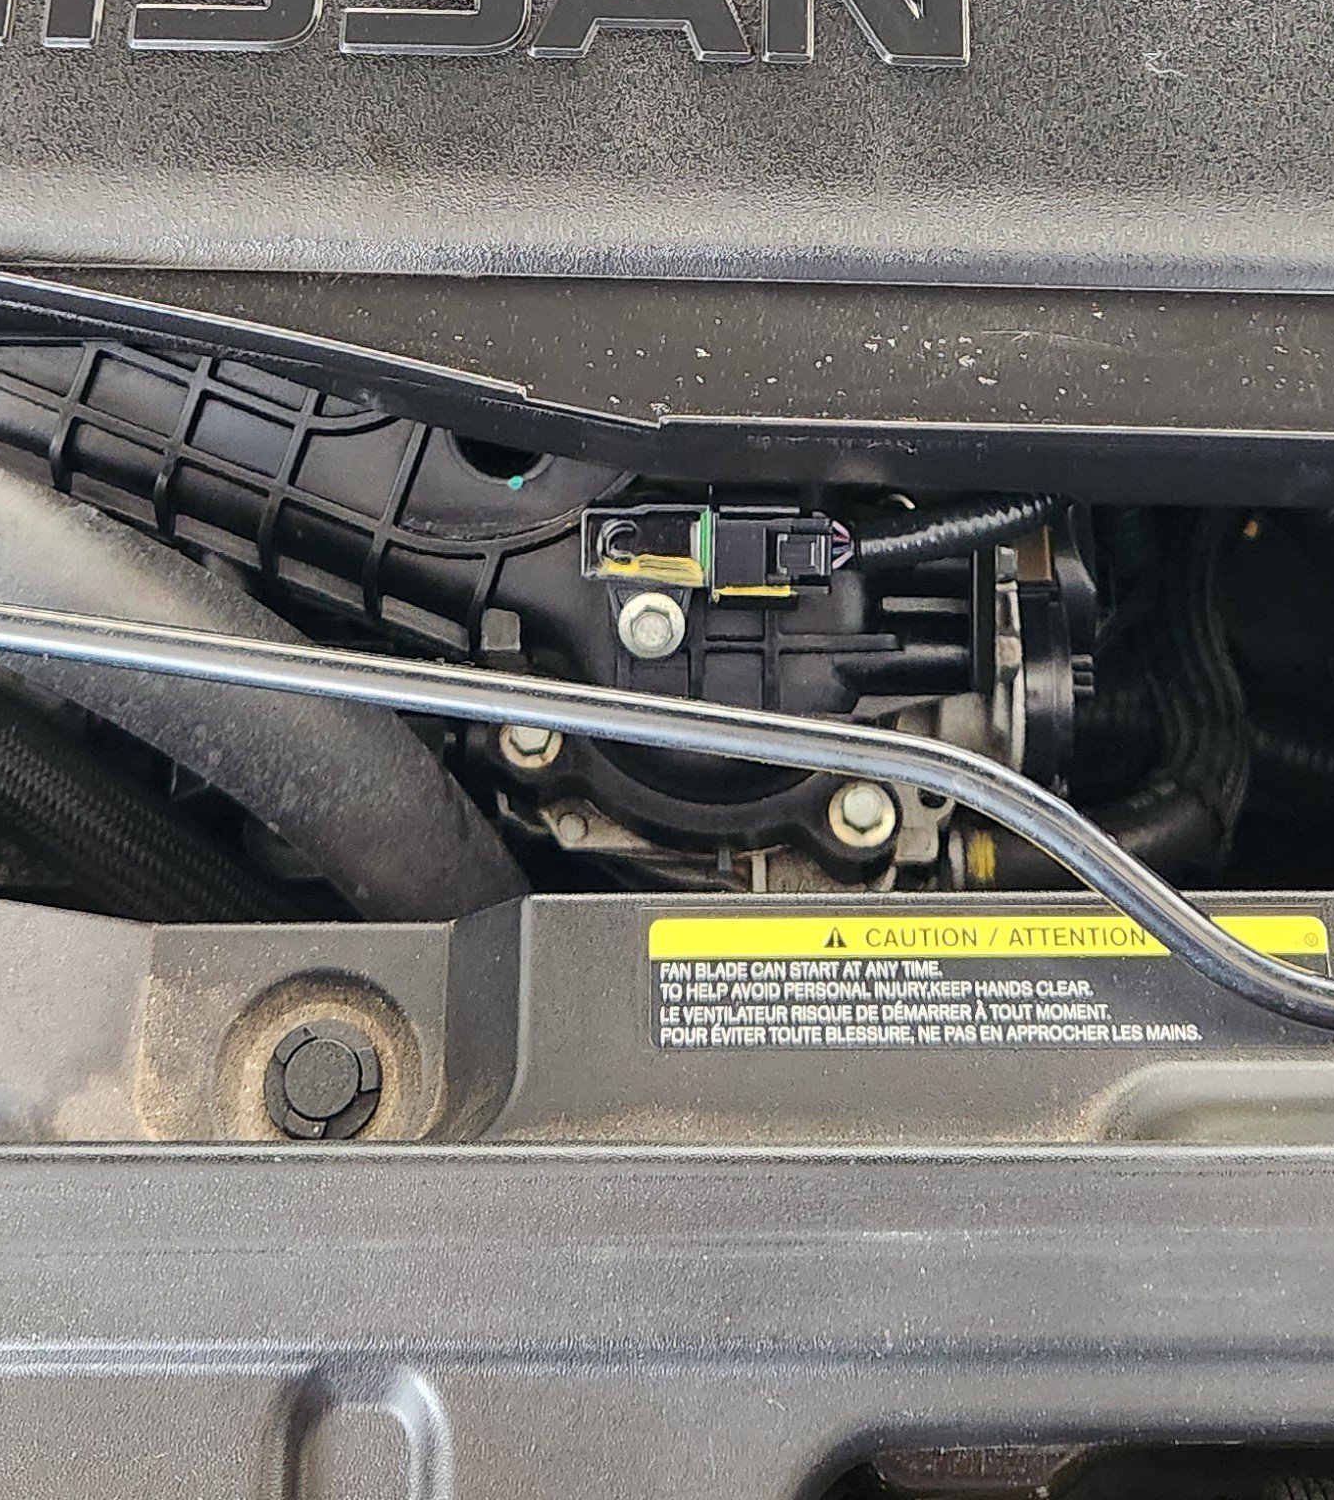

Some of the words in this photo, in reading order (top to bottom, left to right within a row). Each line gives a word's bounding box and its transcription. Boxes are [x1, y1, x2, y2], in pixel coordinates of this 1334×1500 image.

[865, 927, 978, 949] CAUTION
[1009, 926, 1147, 948] ATTENTION
[660, 962, 694, 982] FAN
[695, 961, 748, 981] BLADE
[750, 961, 787, 981] CAN
[788, 961, 840, 980] START
[842, 961, 863, 980] AT
[866, 960, 898, 980] ANY
[900, 960, 944, 979] TIME.
[660, 983, 684, 1002] TO
[686, 982, 729, 1002] HELP
[731, 982, 782, 1001] AVOID
[784, 981, 872, 1001] PERSONAL
[975, 980, 1033, 999] HANDS
[1036, 980, 1094, 998] CLEAR.
[660, 1005, 681, 1025] LE
[683, 1005, 789, 1025] VENTILATEUR
[791, 1004, 853, 1024] RISQUE
[855, 1004, 880, 1023] DE
[881, 1001, 973, 1023] DÉMARRER
[975, 999, 988, 1022] À
[989, 1003, 1034, 1021] TOUT
[1035, 1003, 1113, 1021] MOMENT.
[660, 1026, 708, 1047] POUR
[710, 1021, 767, 1046] ÉVITER
[768, 1026, 823, 1045] TOUTE
[824, 1025, 916, 1045] BLESSURE,
[917, 1025, 942, 1044] NE
[944, 1024, 978, 1044] PAS
[979, 1024, 1004, 1043] EN
[1005, 1024, 1112, 1044] APPROCHER
[1112, 1024, 1145, 1042] LES
[1145, 1024, 1204, 1043] MAINS.
